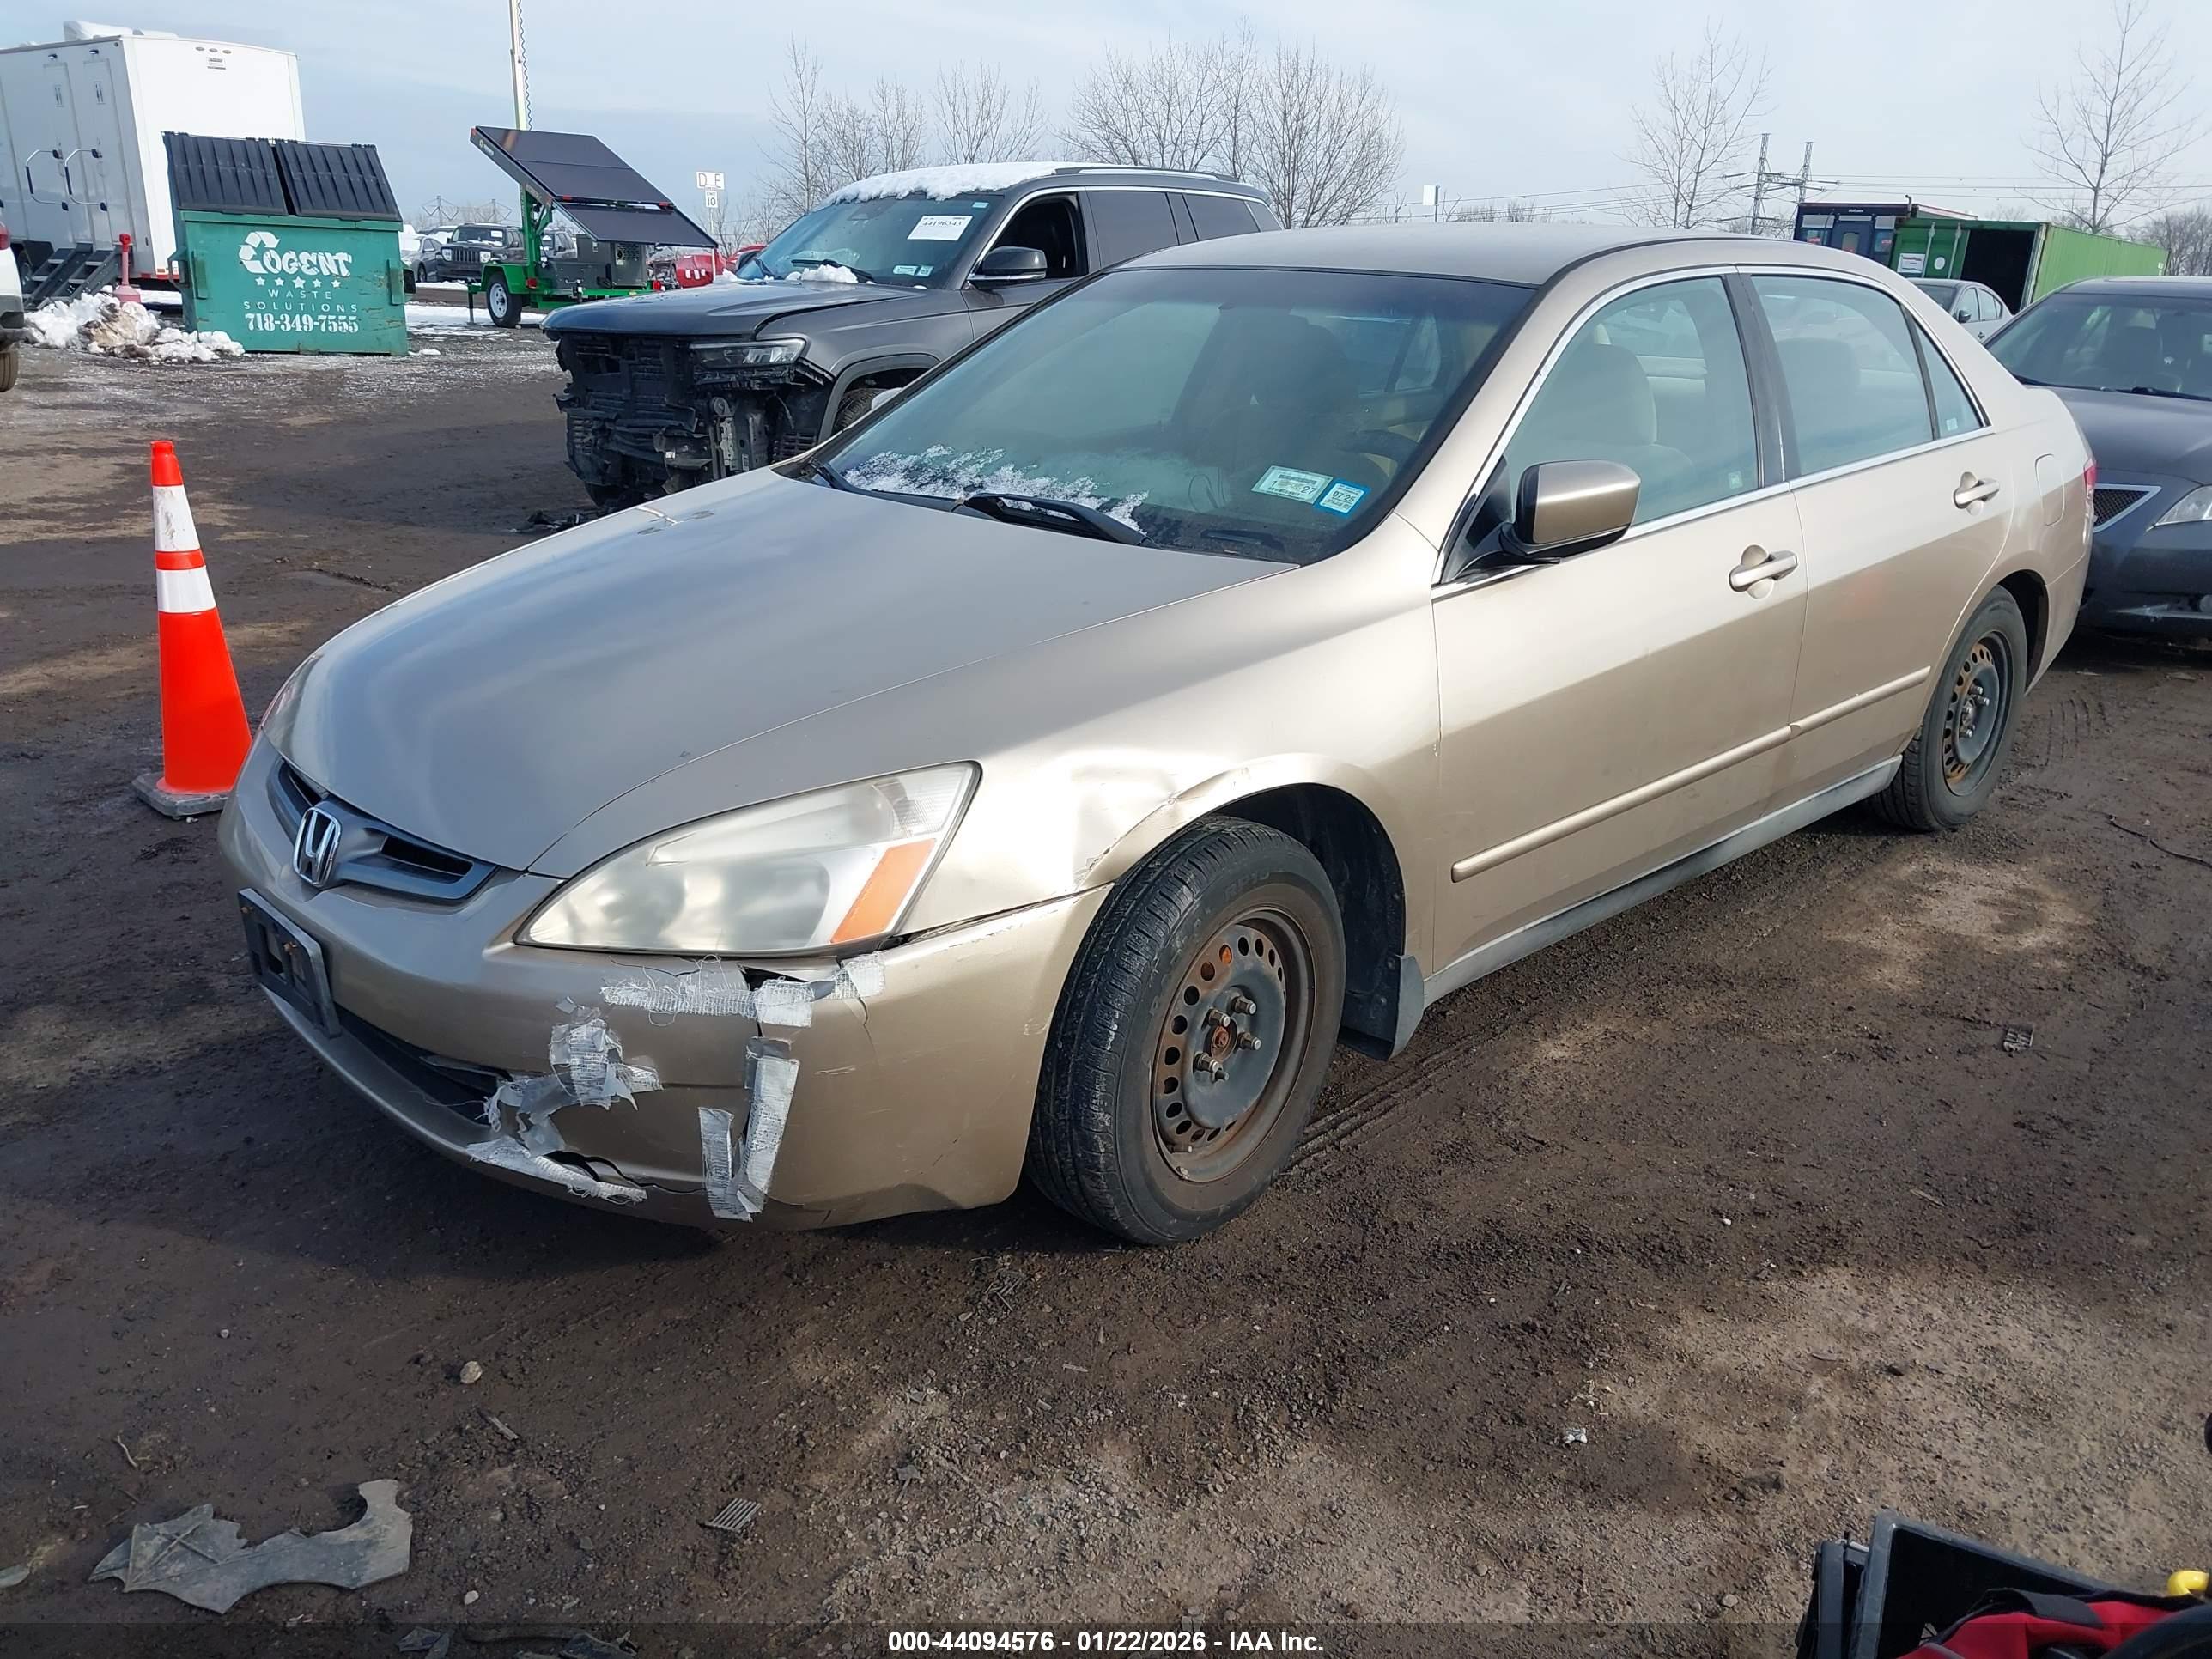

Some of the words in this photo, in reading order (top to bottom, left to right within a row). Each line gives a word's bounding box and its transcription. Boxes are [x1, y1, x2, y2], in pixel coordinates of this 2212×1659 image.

[707, 197, 716, 206] 10
[268, 289, 332, 300] WASTE
[243, 301, 358, 313] SOLUTIONS
[245, 313, 359, 333] 718-349-7555
[1300, 485, 1318, 495] 27
